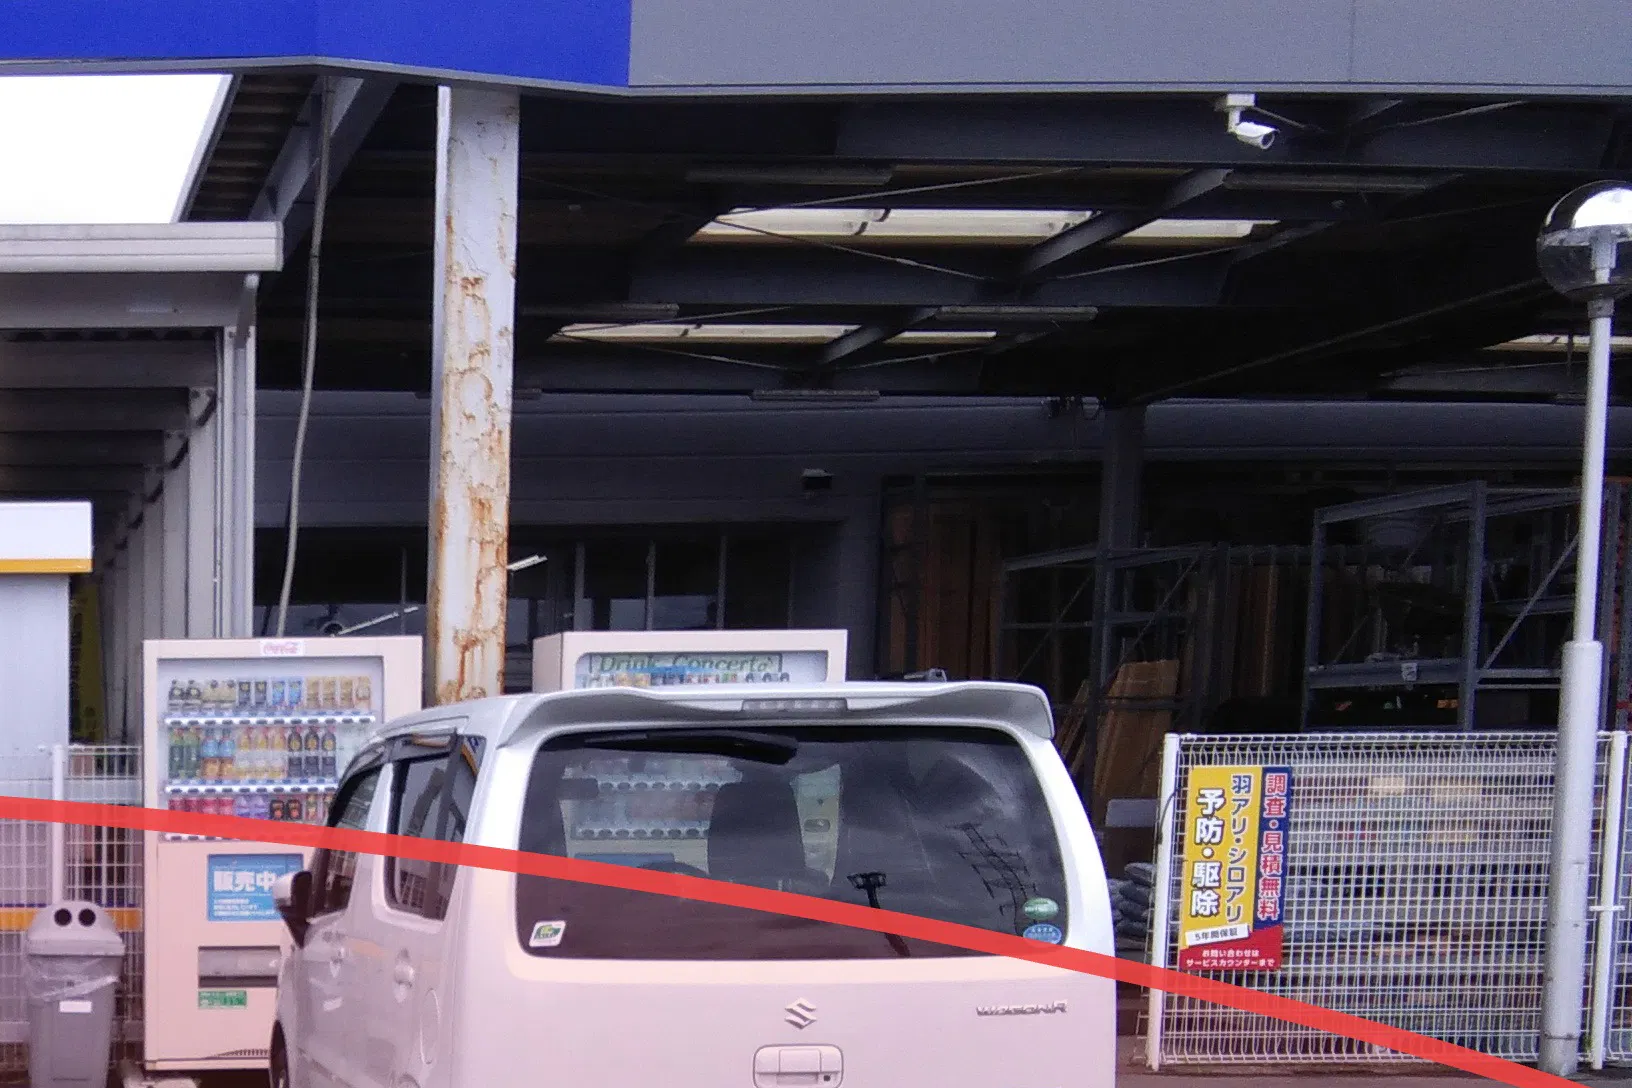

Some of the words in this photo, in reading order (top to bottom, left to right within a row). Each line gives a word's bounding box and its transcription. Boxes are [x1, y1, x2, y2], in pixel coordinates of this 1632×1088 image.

[599, 653, 658, 671] Drink
[1190, 788, 1226, 918] 予防・駆除
[1225, 773, 1252, 923] 羽アリ・シロアリ
[1257, 773, 1288, 922] 調査・見積無料
